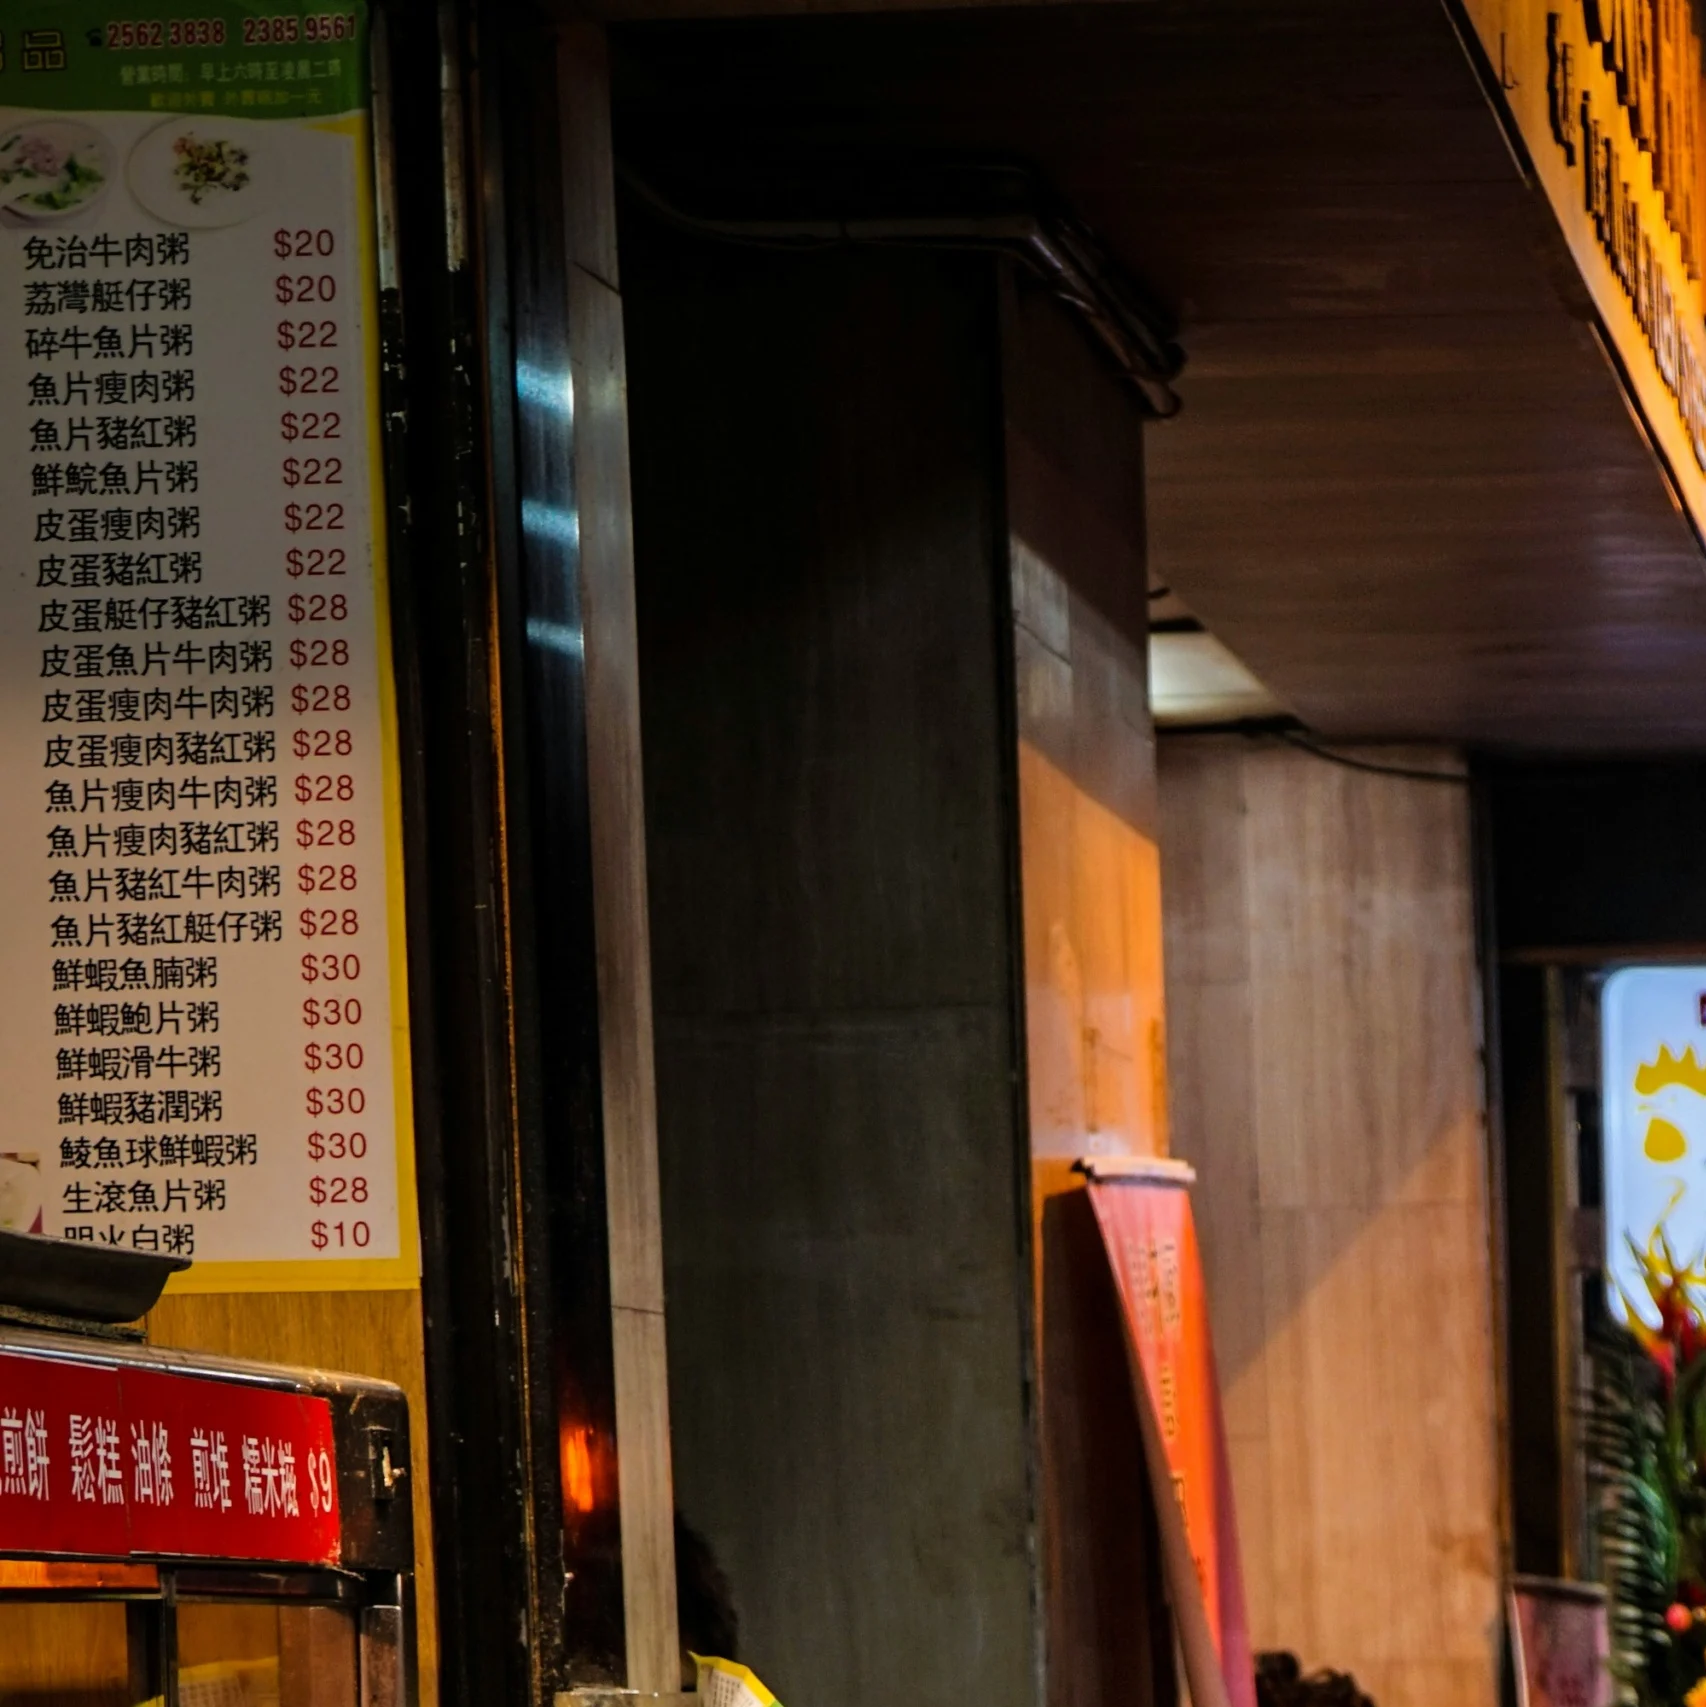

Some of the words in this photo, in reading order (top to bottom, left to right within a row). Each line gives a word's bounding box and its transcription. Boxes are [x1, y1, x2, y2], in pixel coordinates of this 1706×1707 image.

[0, 29, 67, 72] 品
[107, 22, 164, 48] 2562
[169, 20, 226, 46] 3838
[244, 17, 300, 44] 2385
[305, 14, 356, 42] 9561
[24, 233, 190, 271] 免治牛肉粥
[275, 229, 335, 261] $20
[277, 275, 337, 307] $20
[26, 324, 193, 362] 碎牛魚片粥
[278, 321, 338, 352] $22
[29, 370, 195, 407] 魚片瘦肉粥
[280, 366, 340, 397] $22
[30, 416, 197, 453] 魚片豬紅粥
[282, 412, 341, 444] $22
[284, 458, 343, 489] $22
[35, 507, 201, 543] 皮蛋瘦肉粥
[286, 503, 345, 535] $22
[37, 552, 203, 589] 皮蛋豬紅粥
[287, 549, 347, 580] $22
[39, 596, 271, 634] 皮蛋艇仔豬紅粥
[289, 594, 349, 626] $28
[41, 641, 273, 679] 皮蛋魚片牛肉粥
[291, 639, 350, 671] $28
[43, 686, 275, 724] 皮蛋瘦肉牛肉粥
[292, 685, 351, 716] $28
[45, 732, 276, 769] 皮蛋瘦肉豬紅粥
[294, 730, 353, 761] $28
[46, 776, 278, 814] 魚片瘦肉牛肉粥
[296, 774, 355, 806] $28
[47, 822, 279, 859] 魚片瘦肉豬紅粥
[298, 820, 356, 851] $28
[50, 866, 281, 903] 魚片豬紅牛肉粥
[299, 865, 358, 895] $28
[52, 911, 283, 948] 魚片豬紅艇仔粥
[301, 909, 359, 940] $28
[303, 954, 361, 985] $30
[55, 1001, 220, 1037] 鮮蝦鮑片粥
[304, 999, 362, 1029] $30
[57, 1046, 221, 1082] 鮮蝦滑牛粥
[306, 1043, 364, 1072] $30
[58, 1091, 223, 1126] 鮮蝦豬潤粥
[308, 1088, 366, 1118] $30
[60, 1135, 258, 1170] 鯪魚球鮮蝦粥
[309, 1132, 367, 1163] $30
[311, 1177, 369, 1206] $28
[313, 1221, 371, 1251] $10
[0, 1406, 50, 1501] 煎餅
[68, 1414, 125, 1505] 鬆糕
[130, 1419, 175, 1507] 油條
[190, 1426, 232, 1514] 煎堆
[241, 1434, 300, 1518] 糯米糍
[307, 1447, 332, 1518] $9
